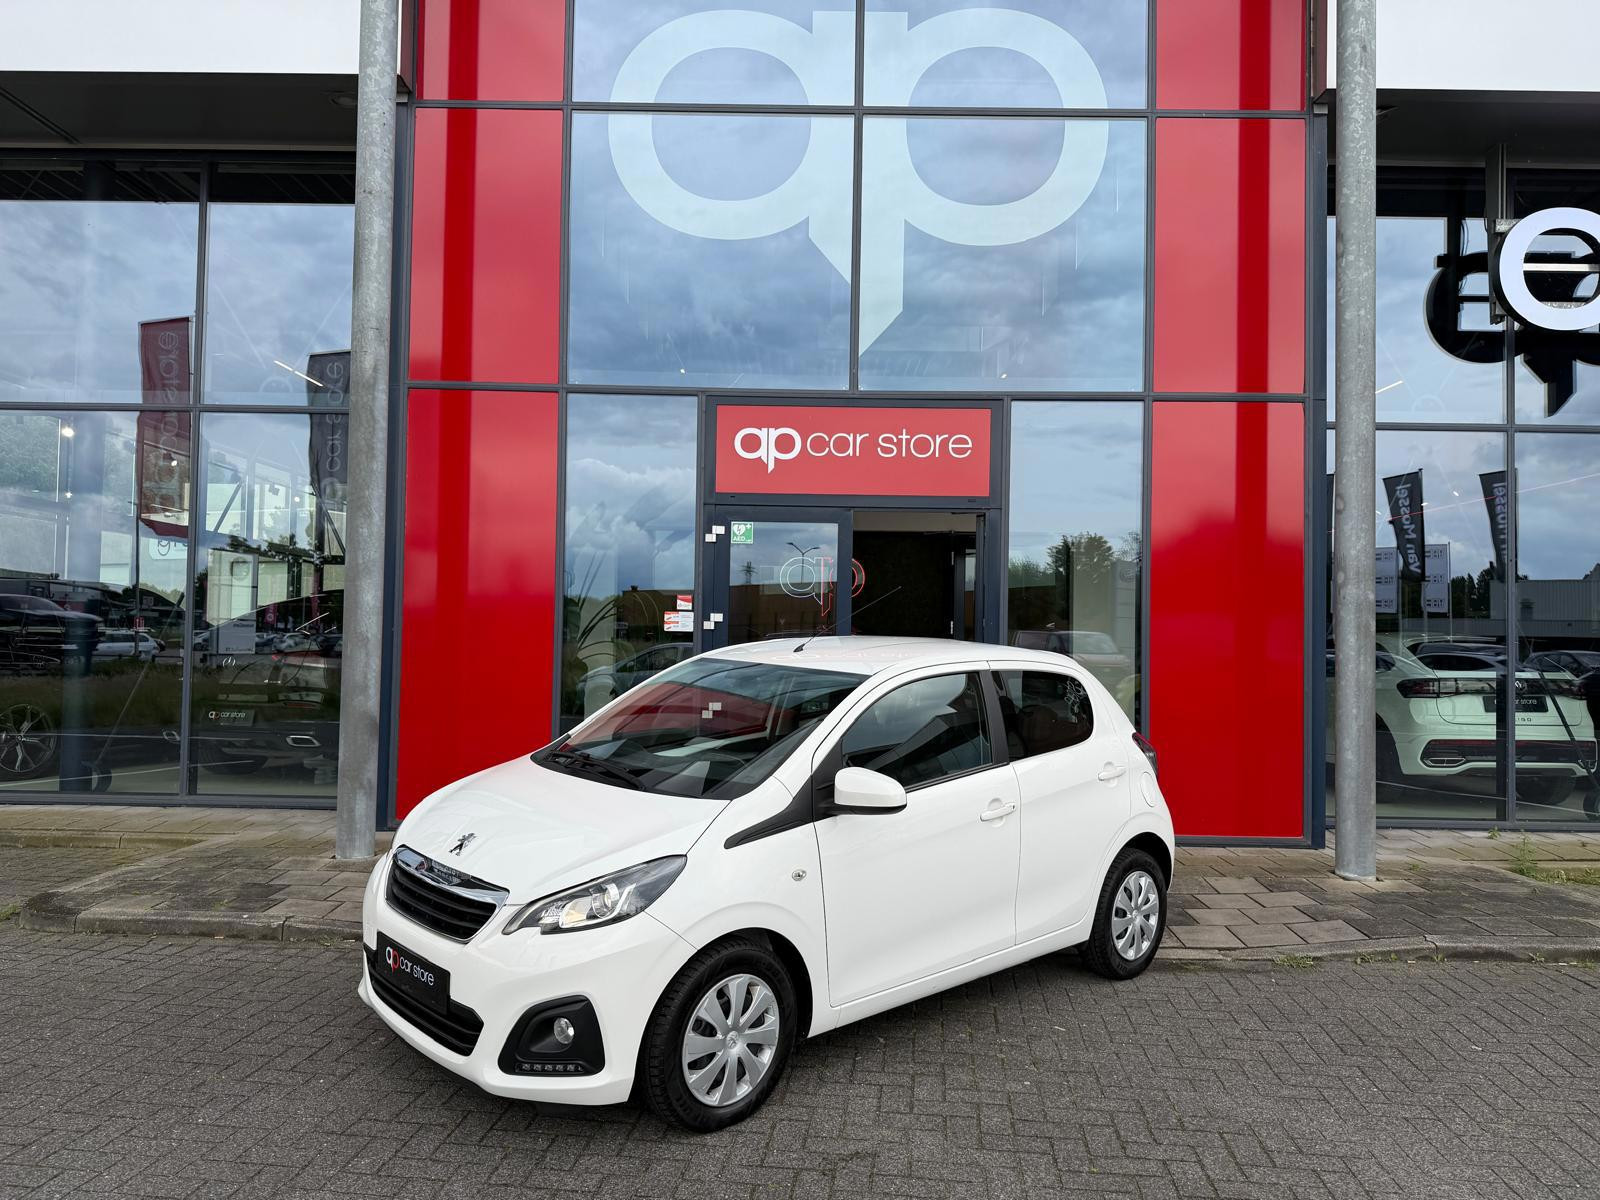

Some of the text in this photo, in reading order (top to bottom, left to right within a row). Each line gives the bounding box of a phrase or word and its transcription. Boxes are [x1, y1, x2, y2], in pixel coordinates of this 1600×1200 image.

[734, 427, 973, 474] ap car store
[400, 956, 412, 974] car
[412, 964, 434, 986] store
